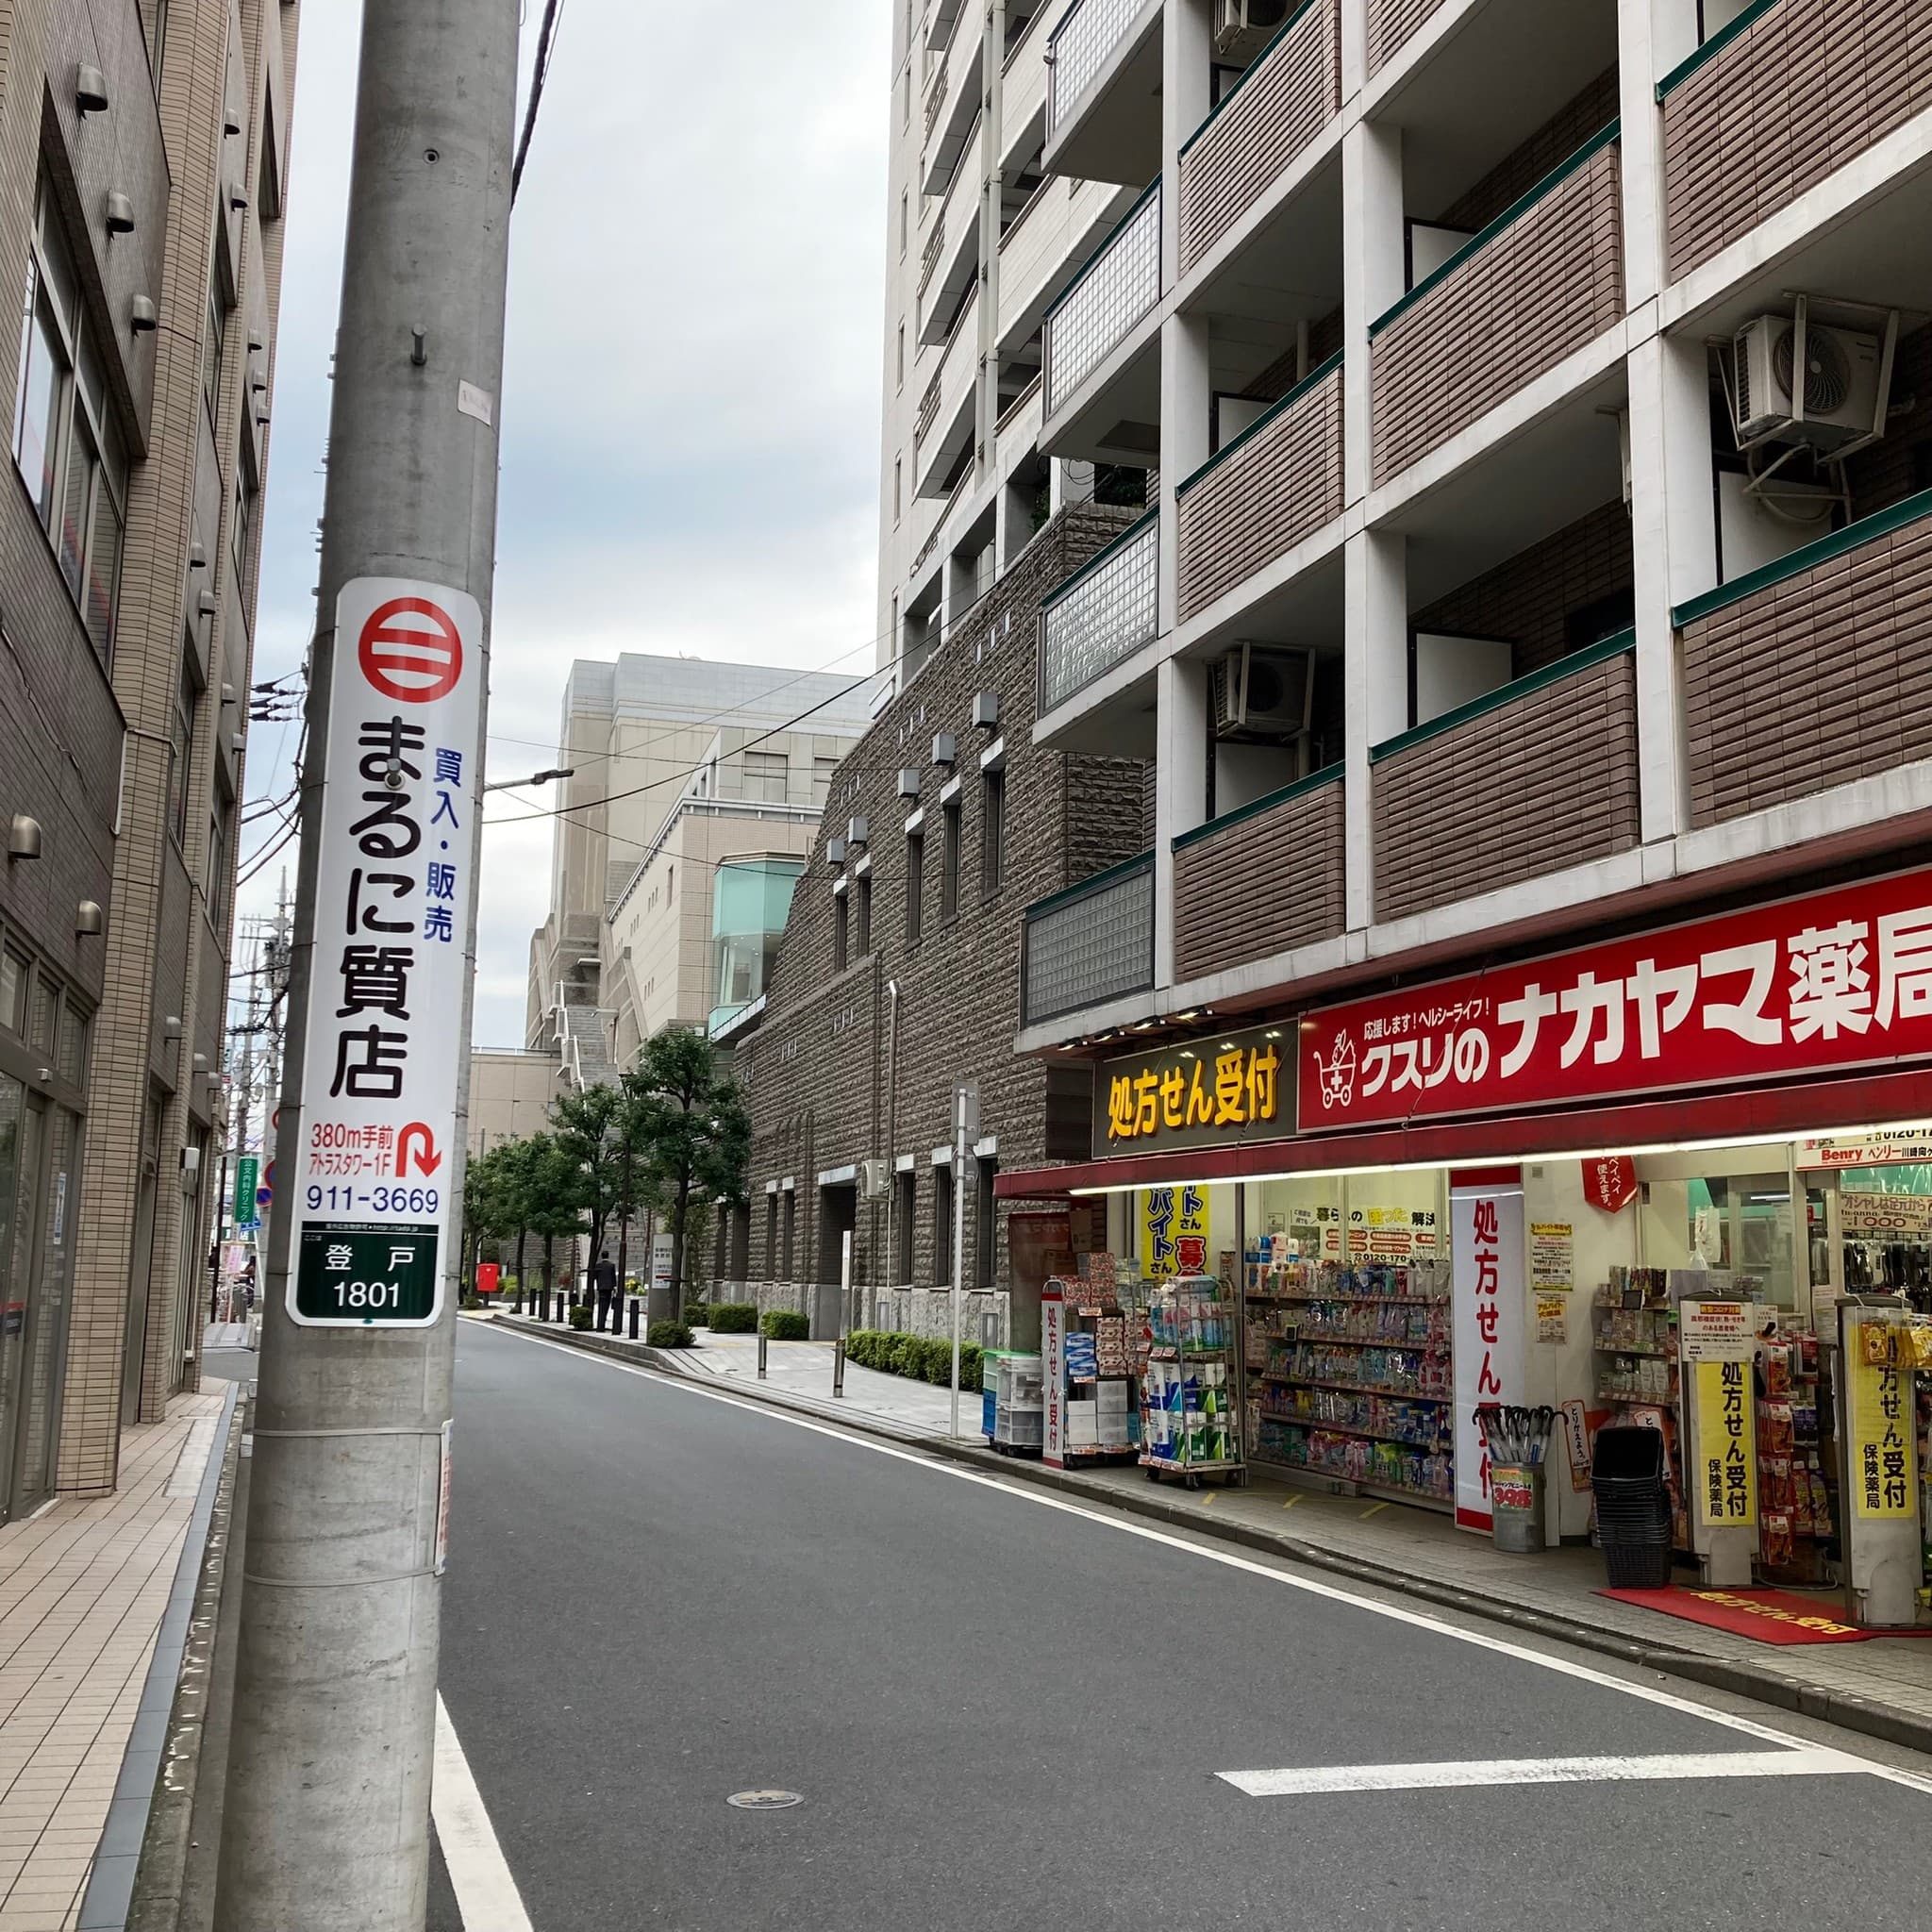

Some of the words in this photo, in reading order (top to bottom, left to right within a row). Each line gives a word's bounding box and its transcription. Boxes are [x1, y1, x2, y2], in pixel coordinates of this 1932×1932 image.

[424, 746, 463, 944] 買入・販売
[325, 715, 425, 1099] まるに質店
[1108, 1044, 1277, 1140] 処方せん受付
[1361, 1027, 1491, 1098] クスリの
[310, 1124, 394, 1150] 380m手前
[1821, 1149, 1863, 1161] Benry
[307, 1185, 439, 1214] 911-3669
[333, 1281, 400, 1307] 1801
[1047, 1306, 1058, 1453] 処方せん受付
[1722, 1362, 1749, 1518] 処方せん受付
[1708, 1458, 1724, 1518] 保険薬局
[1862, 1443, 1881, 1509] 保険薬局
